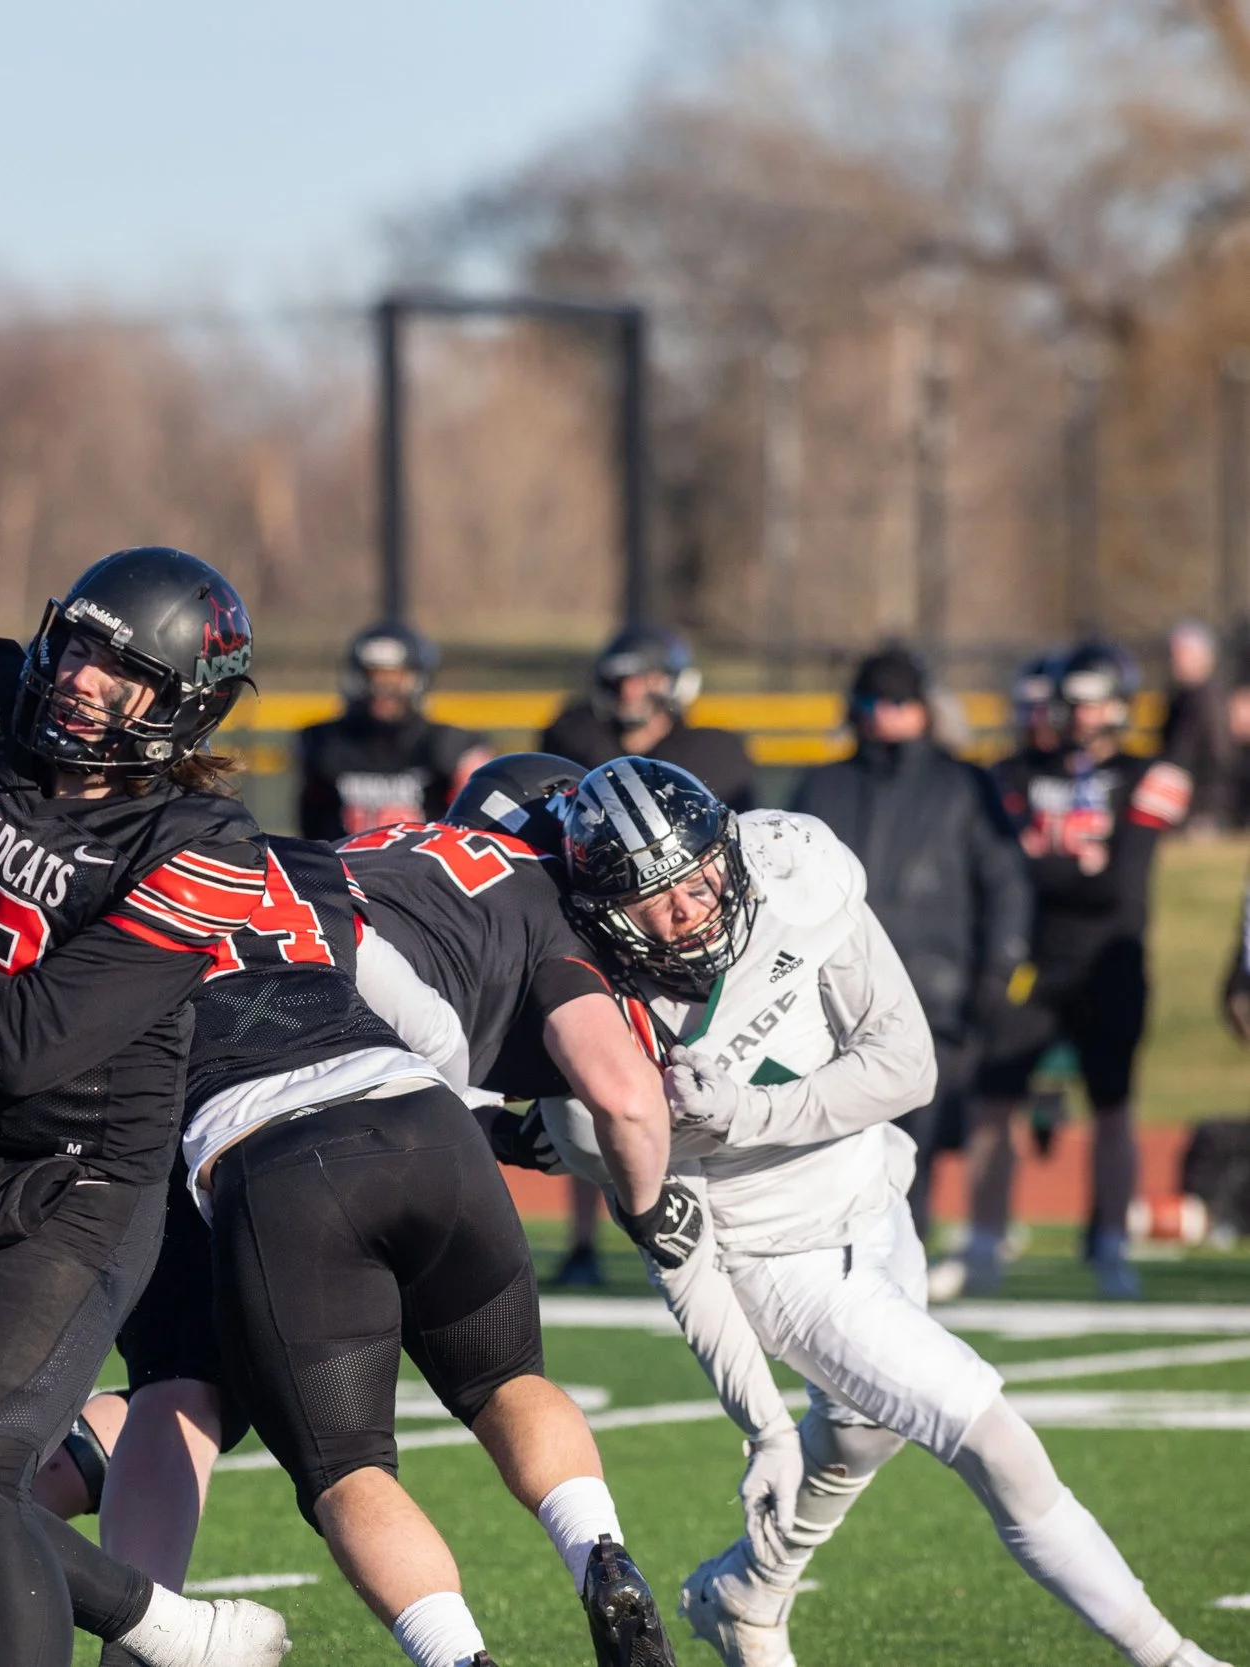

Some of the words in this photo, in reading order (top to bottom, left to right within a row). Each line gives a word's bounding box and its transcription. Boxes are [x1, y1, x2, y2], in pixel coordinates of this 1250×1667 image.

[86, 603, 123, 630] Riddell
[642, 855, 682, 882] COD
[769, 956, 805, 984] adidas
[66, 1142, 83, 1156] M
